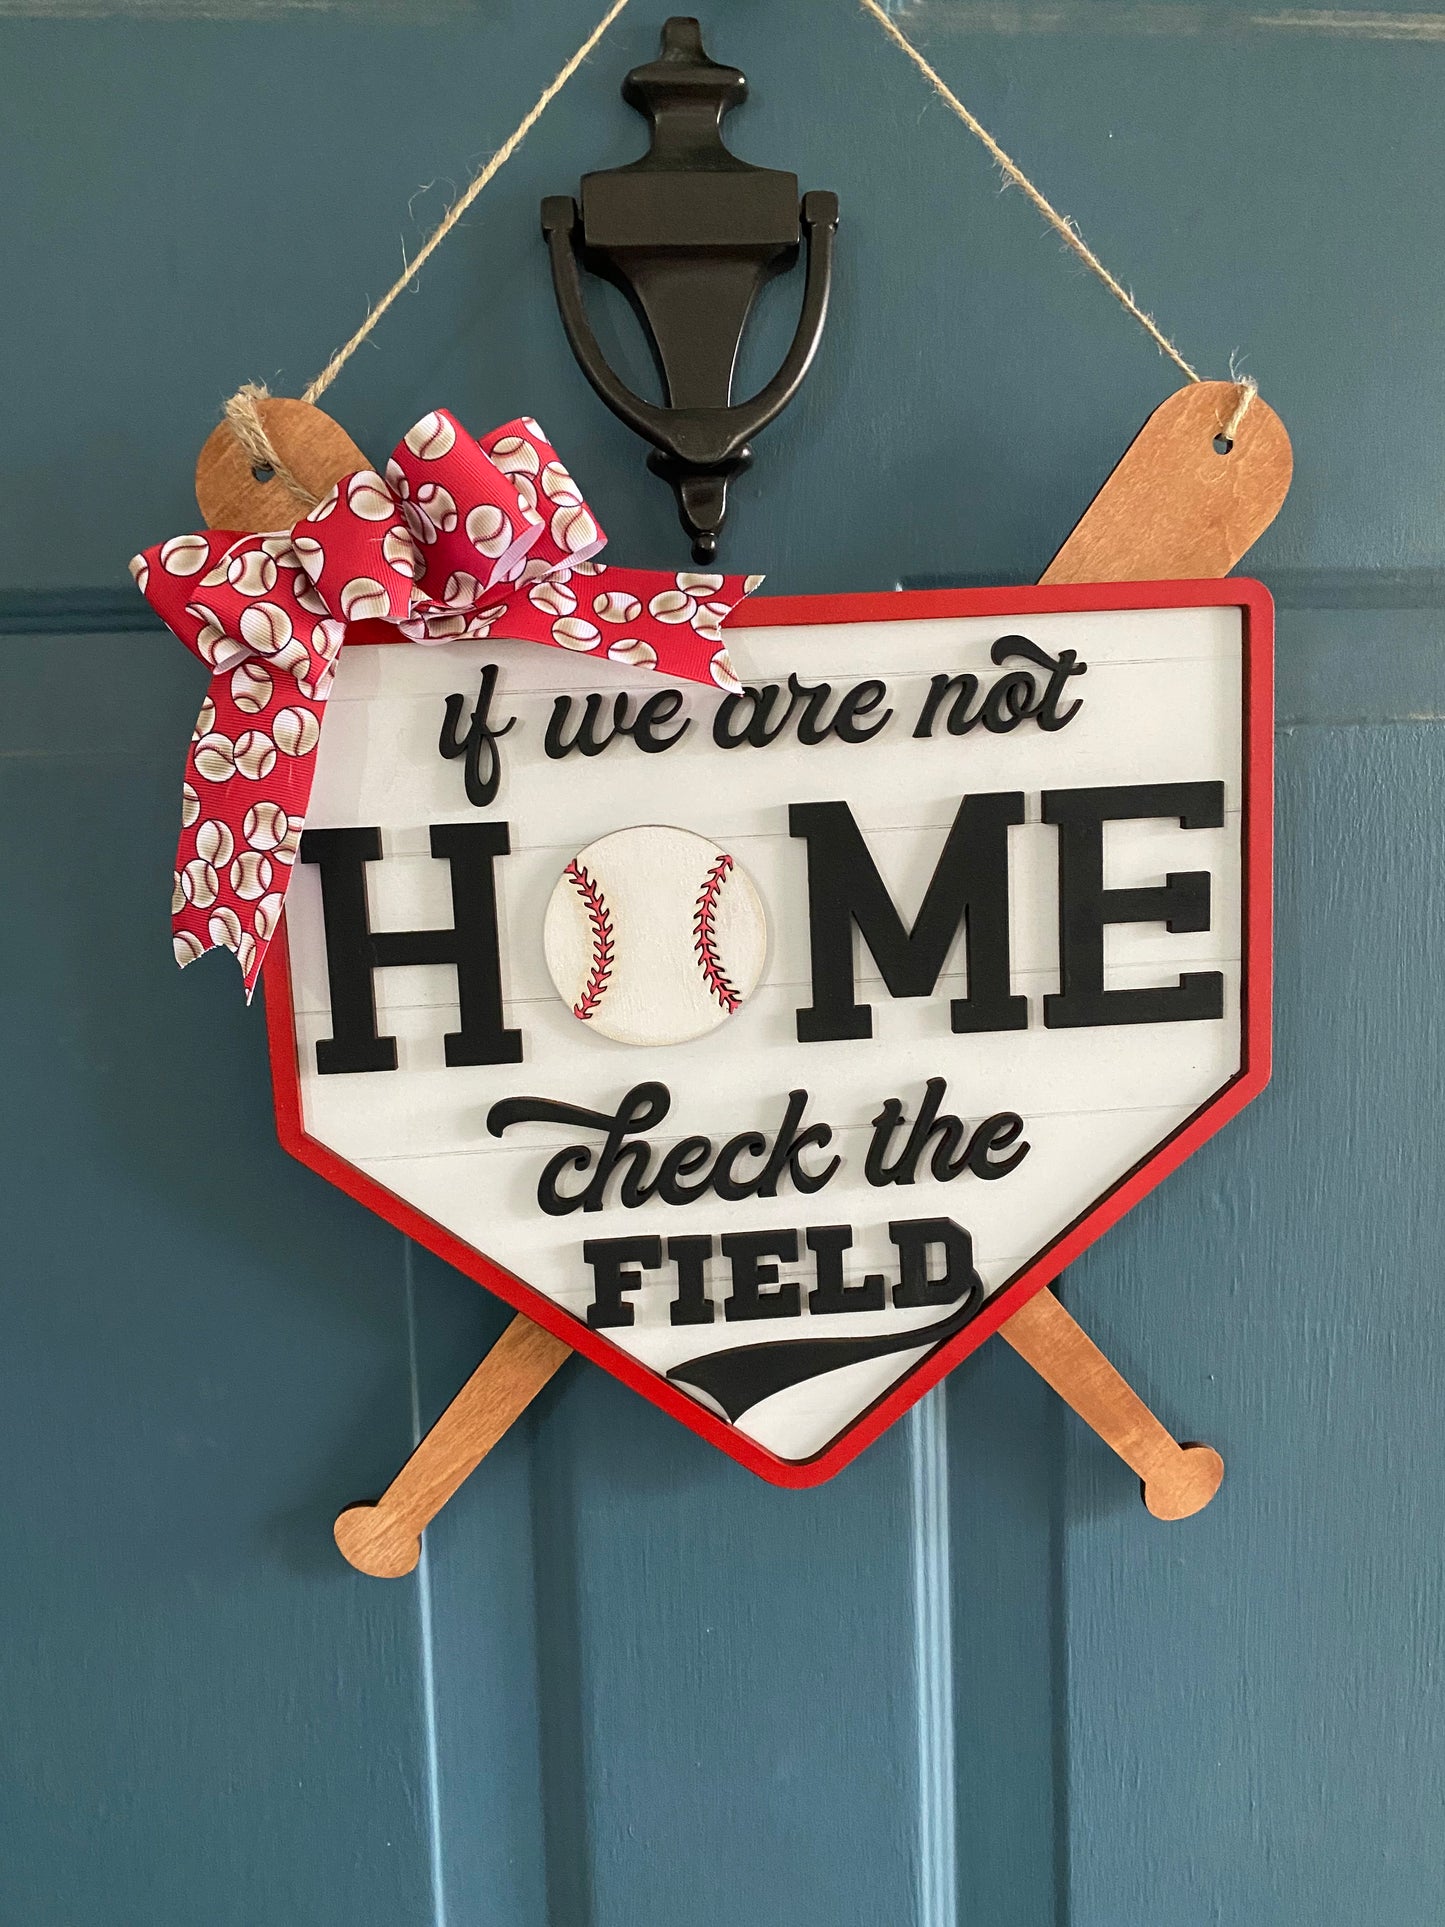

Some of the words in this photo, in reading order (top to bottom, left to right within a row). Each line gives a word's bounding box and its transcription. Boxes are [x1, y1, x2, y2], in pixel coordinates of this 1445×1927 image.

[439, 662, 518, 808] if
[545, 689, 692, 760] we
[711, 671, 894, 751] are
[912, 633, 1089, 739] not
[486, 1081, 842, 1217] check
[863, 1076, 1031, 1188] the
[582, 1216, 978, 1332] FIELD
